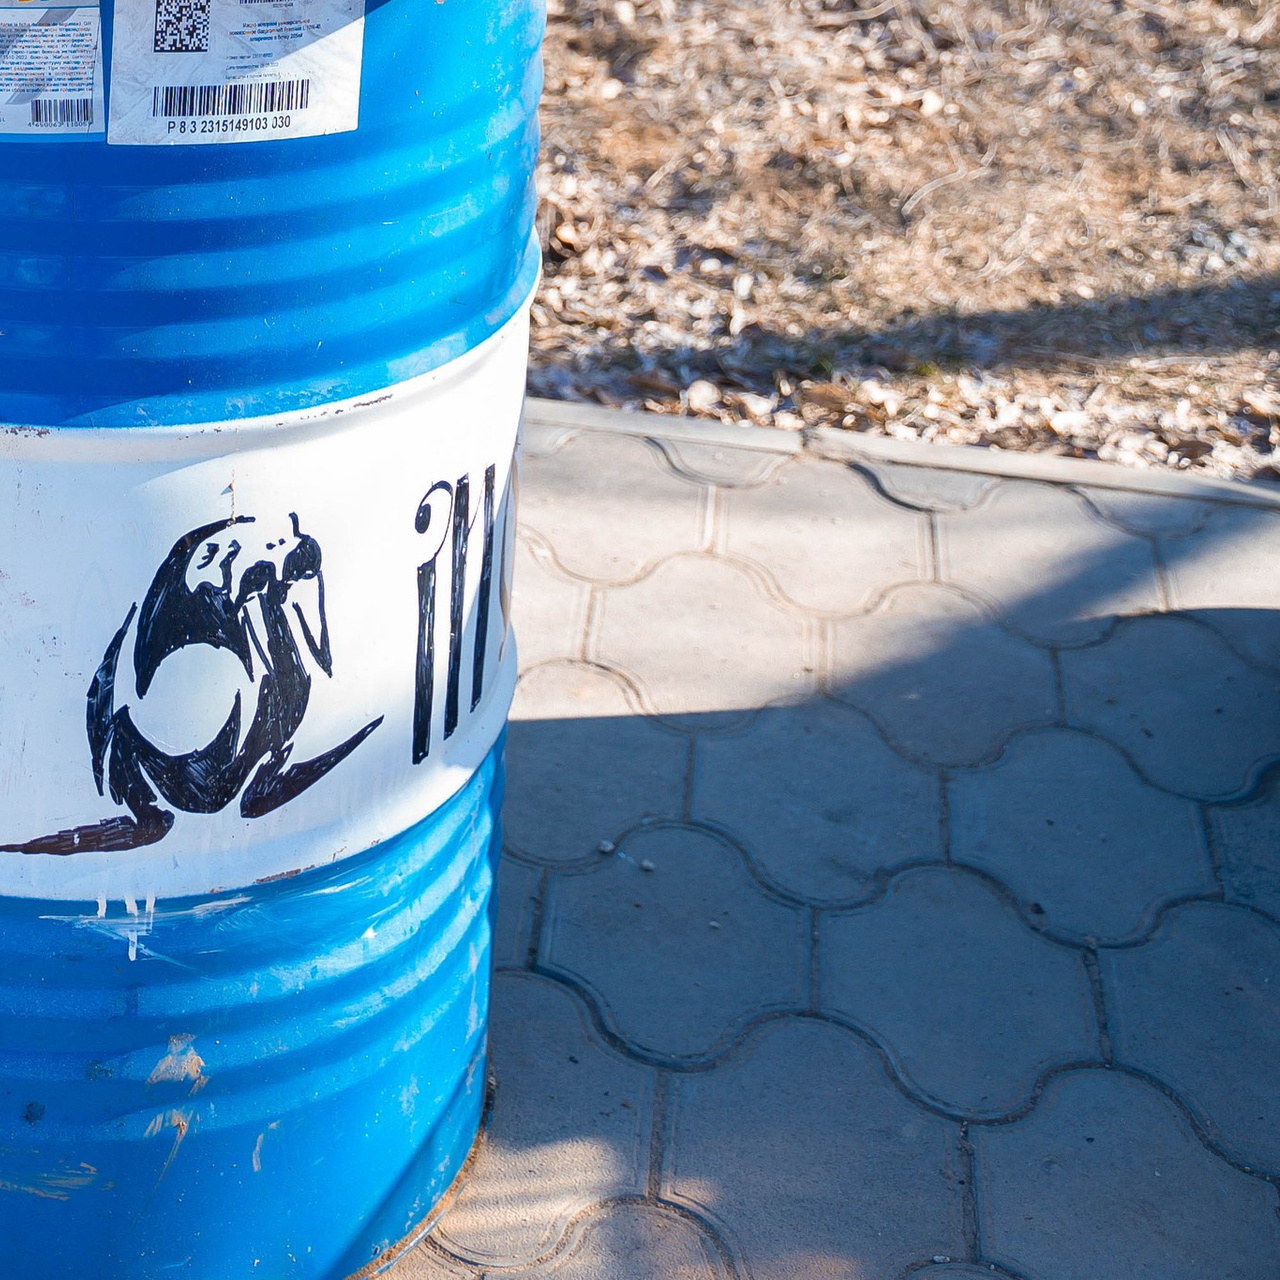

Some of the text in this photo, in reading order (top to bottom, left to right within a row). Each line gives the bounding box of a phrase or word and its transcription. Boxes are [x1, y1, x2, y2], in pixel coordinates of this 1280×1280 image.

[167, 121, 176, 133] P
[179, 121, 186, 133] 8
[190, 121, 197, 133] 3
[200, 117, 268, 133] 2315149103
